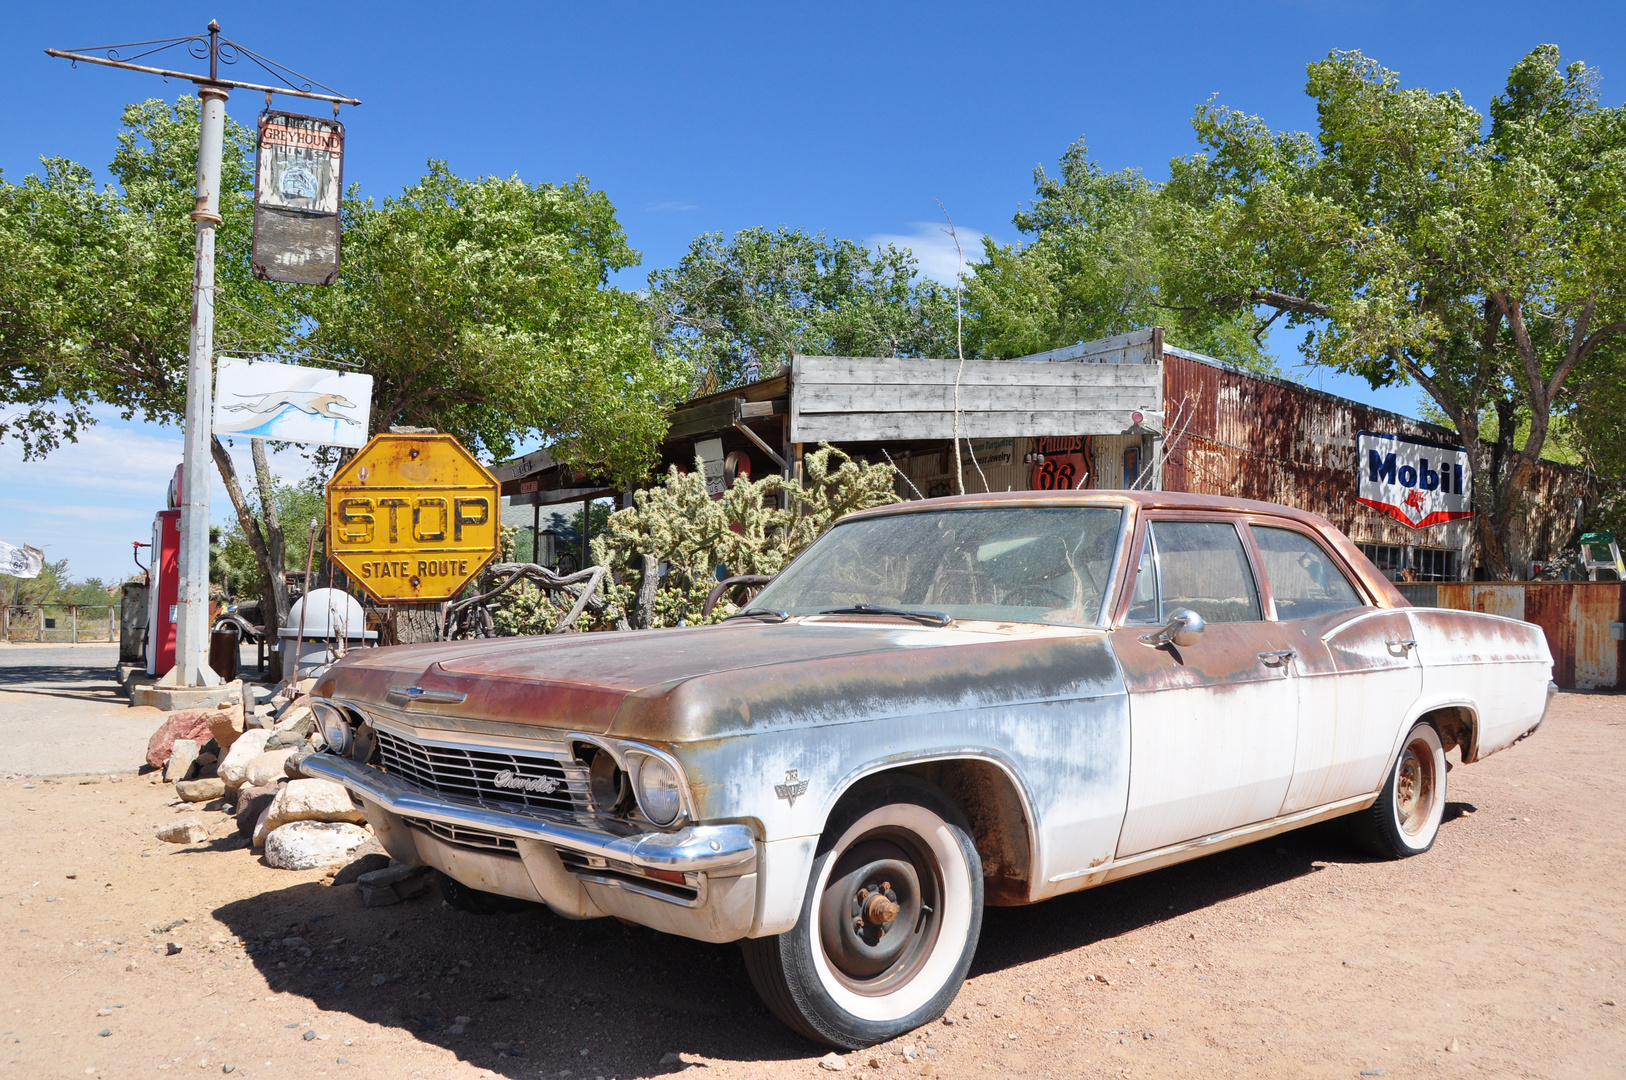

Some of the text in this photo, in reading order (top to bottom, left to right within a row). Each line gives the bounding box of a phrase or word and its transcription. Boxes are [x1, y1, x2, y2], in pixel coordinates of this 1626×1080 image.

[263, 127, 340, 149] GREYHOUND
[987, 452, 1011, 464] Jewelry
[1038, 435, 1083, 458] Phillips
[1037, 459, 1076, 490] 66
[1368, 449, 1463, 495] Mobil
[337, 496, 490, 544] STOP
[361, 558, 469, 579] STATE ROUTE
[493, 768, 558, 795] Chevrolet
